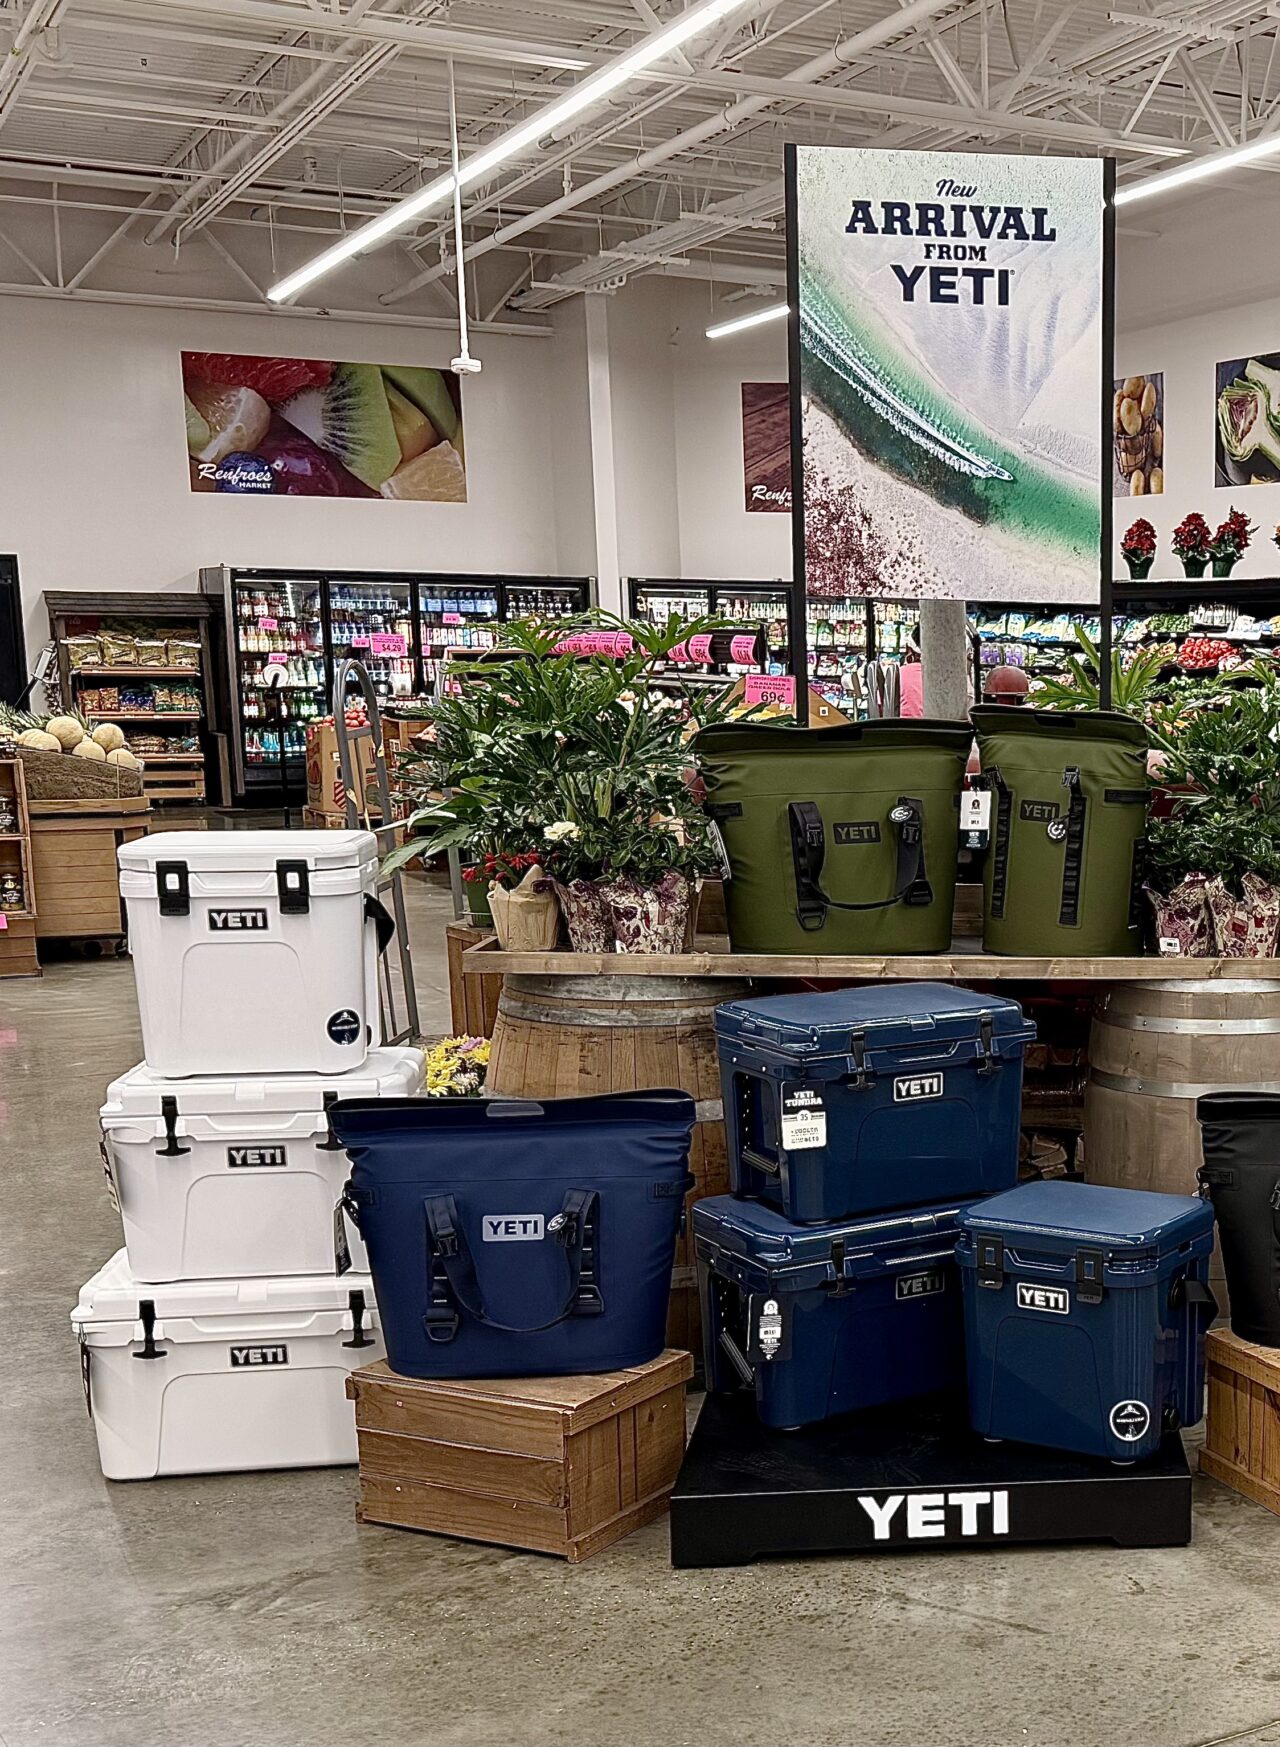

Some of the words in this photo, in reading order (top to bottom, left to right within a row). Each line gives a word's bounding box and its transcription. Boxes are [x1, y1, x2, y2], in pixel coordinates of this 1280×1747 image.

[935, 178, 978, 198] New
[845, 200, 1057, 242] ARRIVAL
[923, 243, 987, 262] FROM
[197, 463, 273, 485] Renfroe's
[751, 484, 792, 505] Renfr
[760, 691, 786, 703] 69¢
[1023, 803, 1057, 820] YETI
[836, 826, 878, 841] YETI
[210, 912, 265, 928] YETI
[793, 1090, 814, 1099] YETI
[898, 1077, 939, 1096] YETI
[784, 1096, 823, 1107] TUNDRA
[230, 1149, 282, 1164] YETI
[487, 1219, 539, 1236] YETI
[899, 1276, 941, 1296] YETI
[1021, 1287, 1066, 1310] YETI
[232, 1348, 285, 1363] YETI
[857, 1490, 1010, 1540] YETI
